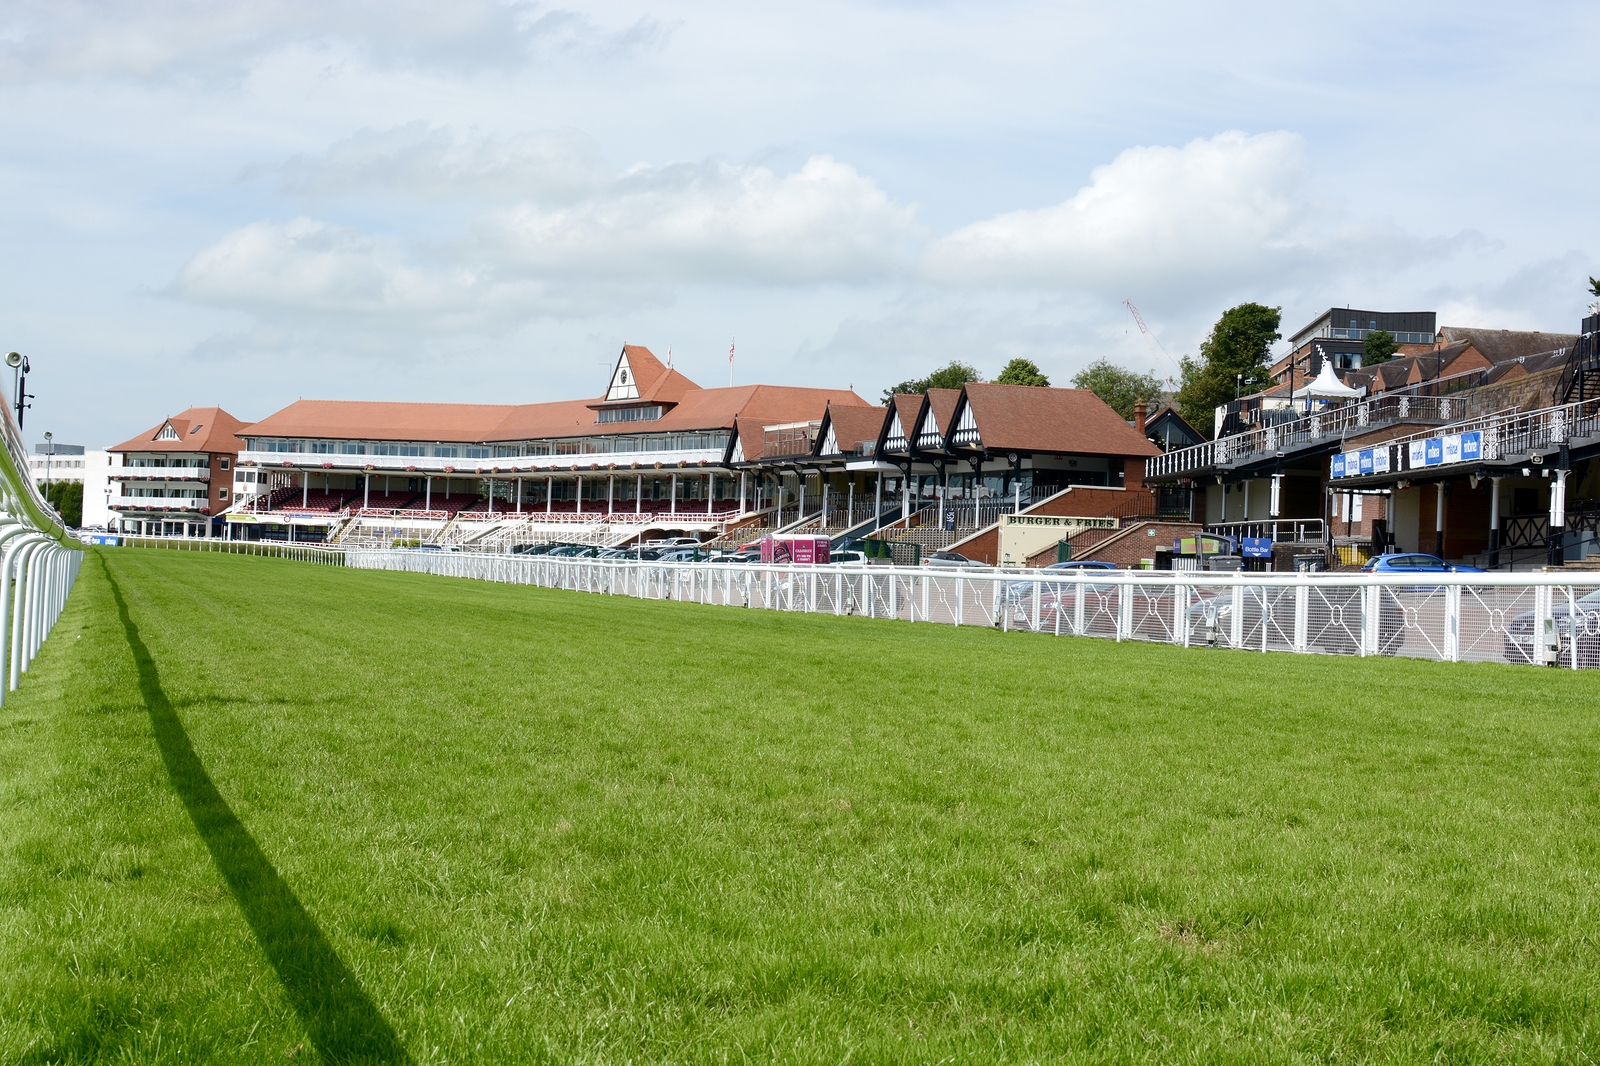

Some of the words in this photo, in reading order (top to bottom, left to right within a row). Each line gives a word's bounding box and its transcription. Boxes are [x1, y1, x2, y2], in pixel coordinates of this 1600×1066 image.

[1428, 446, 1440, 459] mbna
[1463, 440, 1477, 453] mbna
[1009, 516, 1060, 526] BURGER
[1064, 518, 1073, 526] &
[1076, 519, 1115, 528] FRIES
